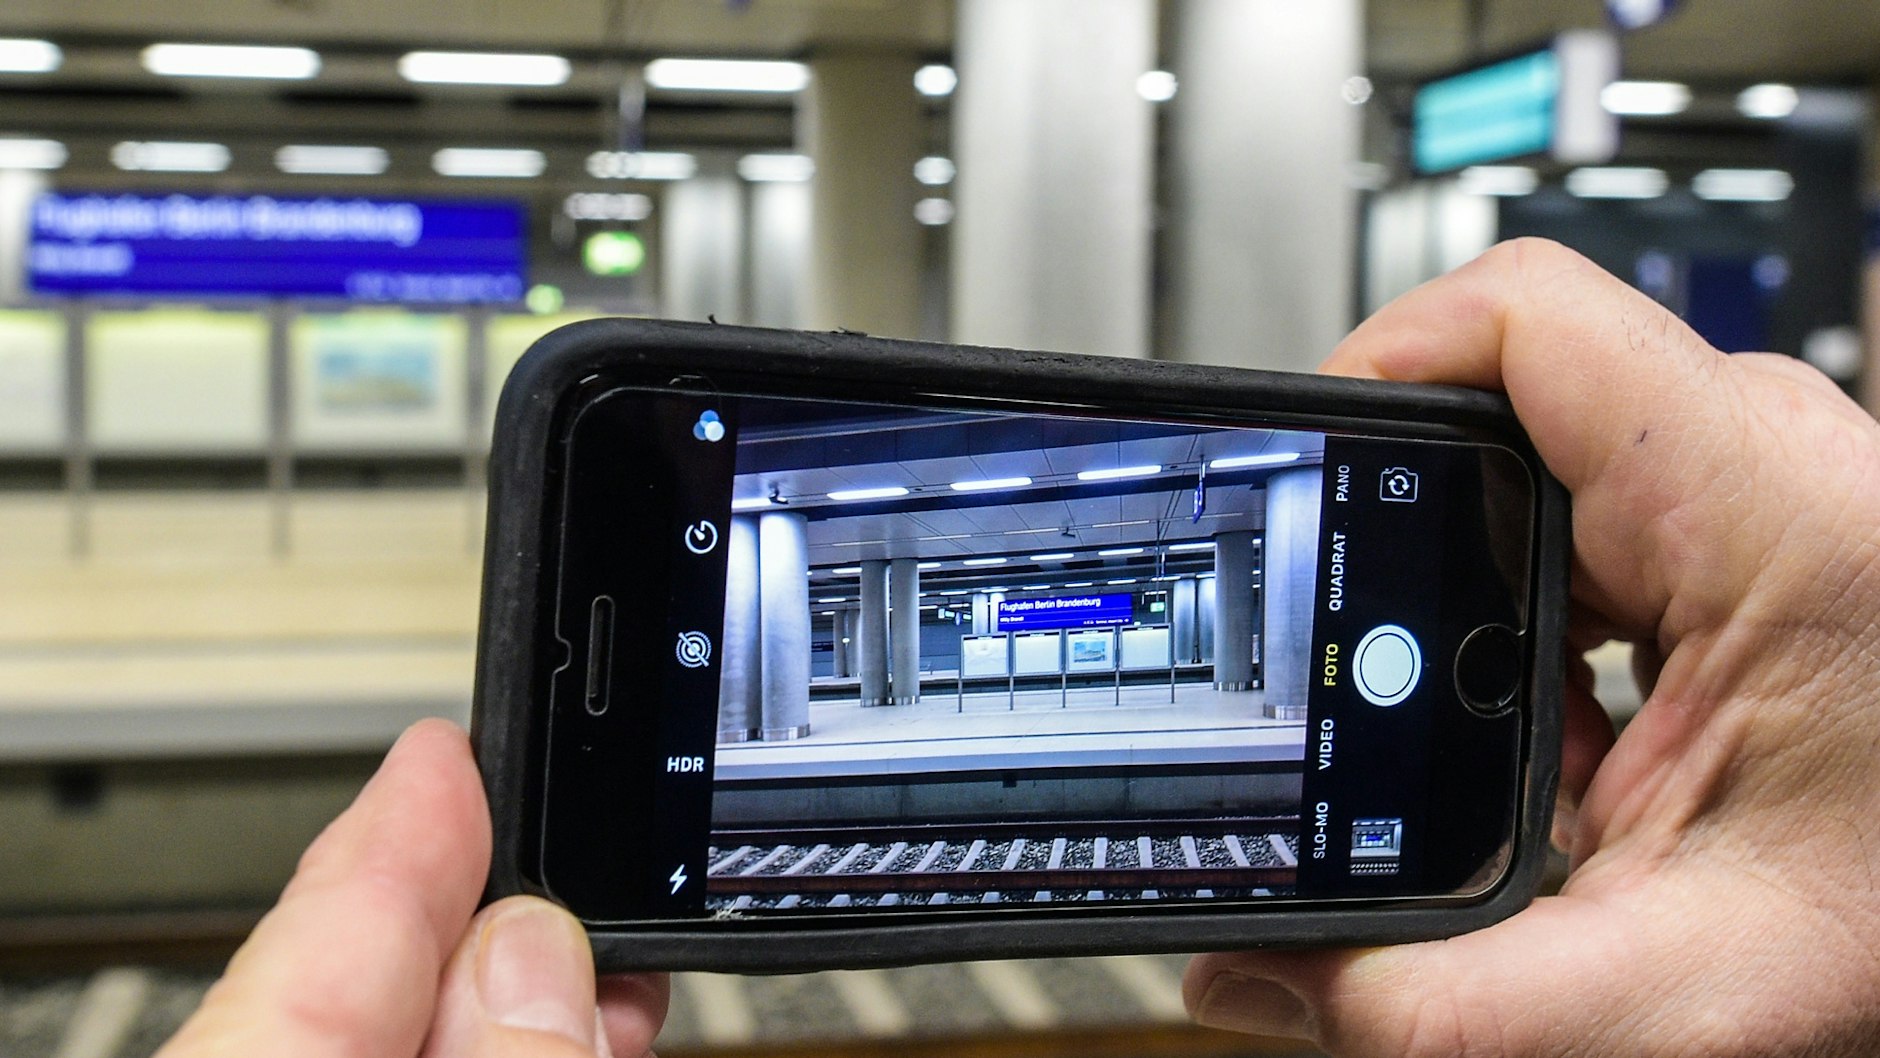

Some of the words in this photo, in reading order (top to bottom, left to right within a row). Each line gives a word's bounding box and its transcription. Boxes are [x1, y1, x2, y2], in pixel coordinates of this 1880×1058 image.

[1336, 465, 1350, 502] PANO
[1329, 532, 1346, 611] QUADRAT
[1000, 601, 1034, 613] Flughafen
[1034, 600, 1056, 610] Berlin
[1056, 598, 1101, 609] Brandenburg
[1324, 643, 1339, 686] FOTO
[666, 756, 705, 773] HDR
[1318, 718, 1334, 770] VIDEO
[1313, 801, 1329, 859] SLO-MO
